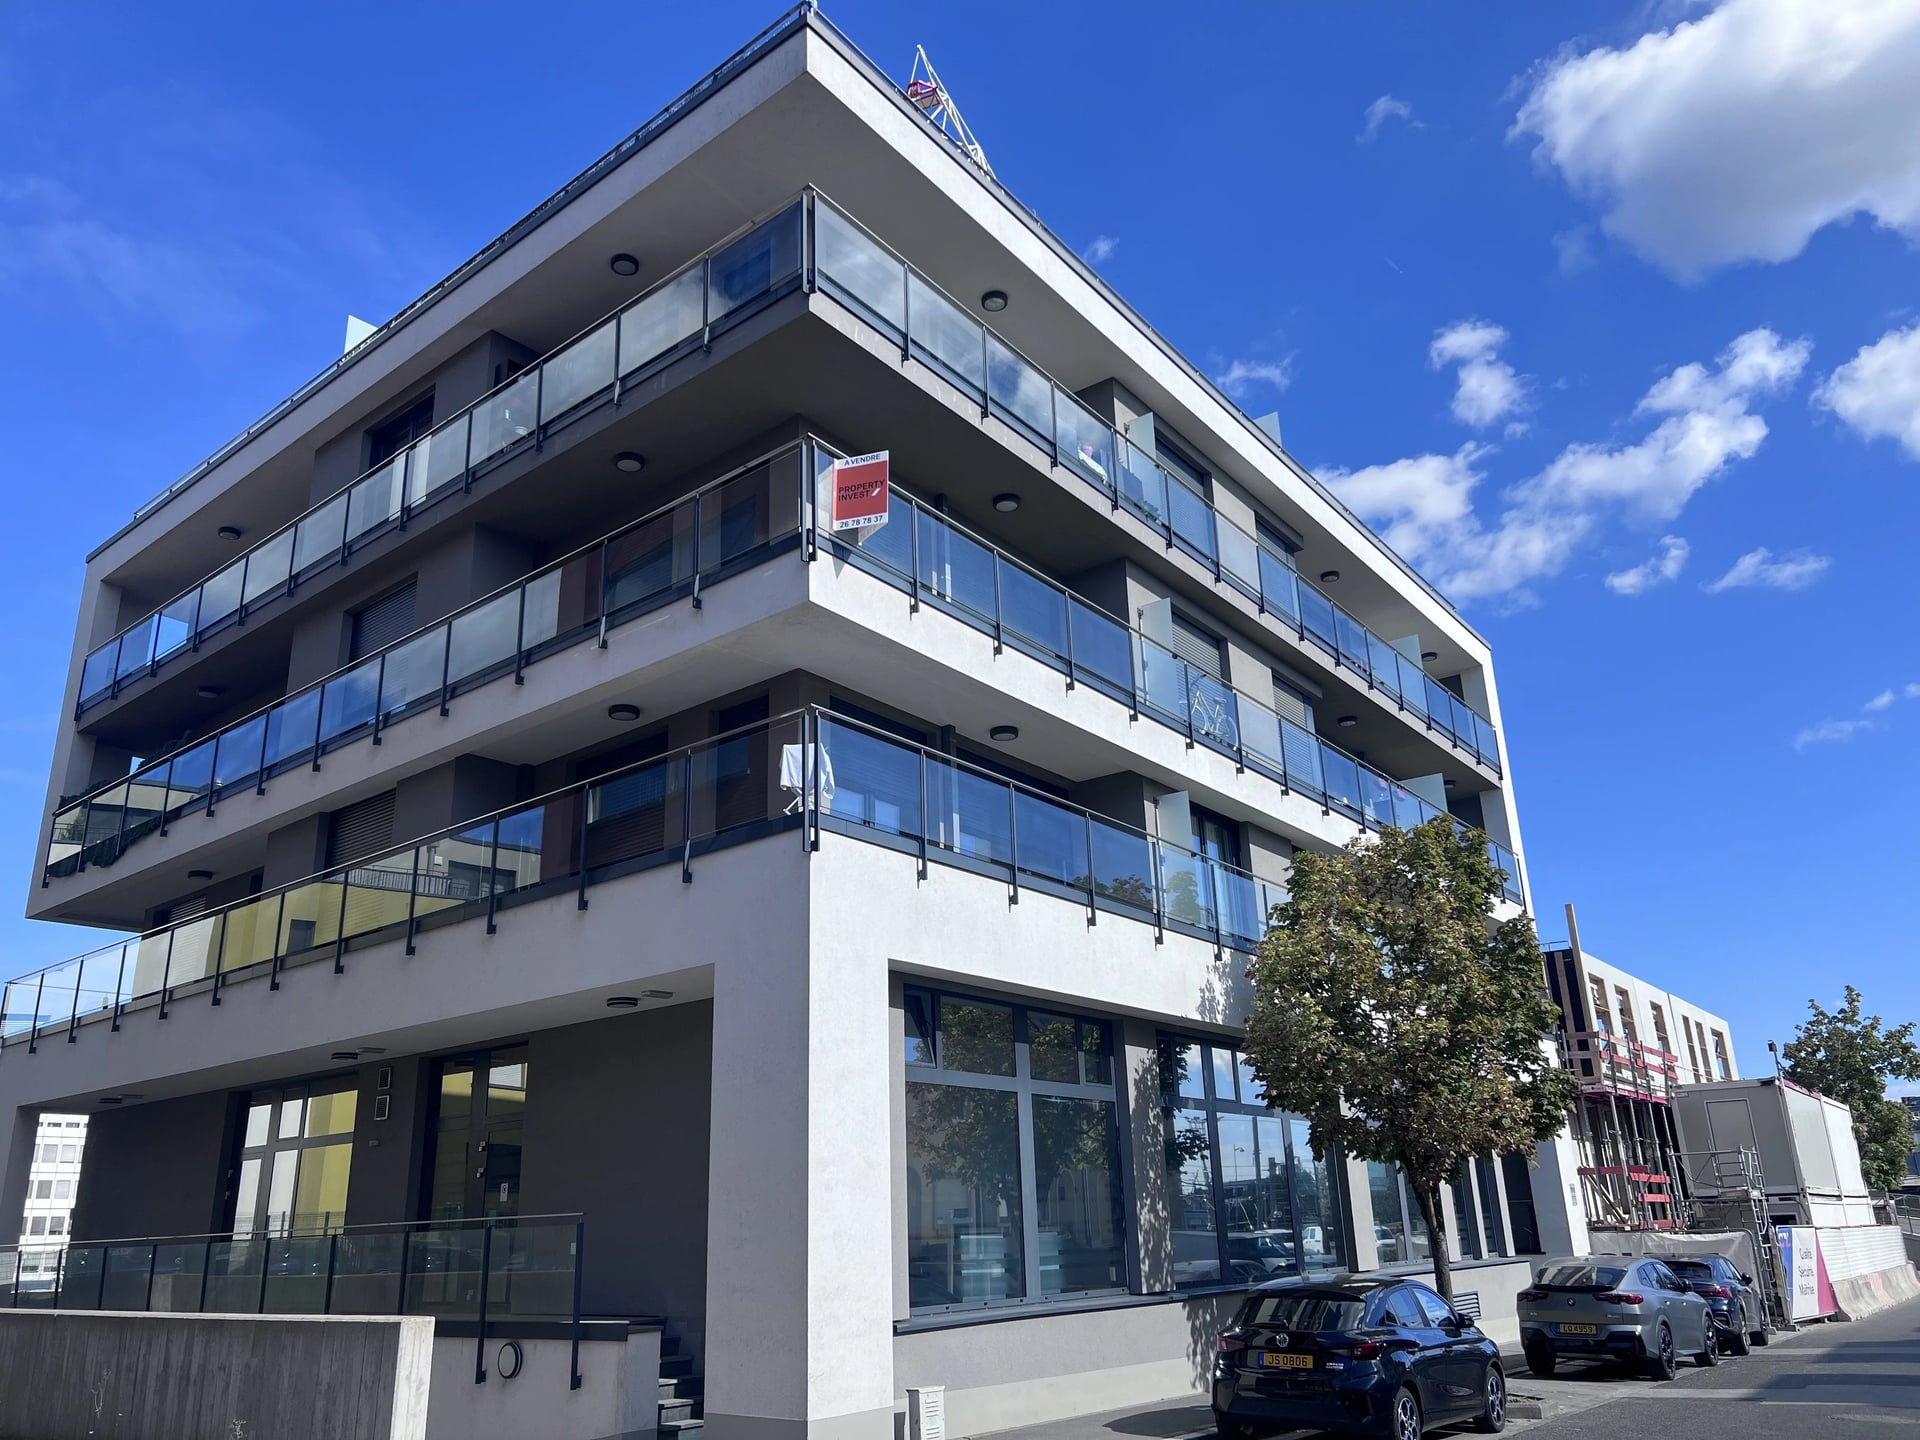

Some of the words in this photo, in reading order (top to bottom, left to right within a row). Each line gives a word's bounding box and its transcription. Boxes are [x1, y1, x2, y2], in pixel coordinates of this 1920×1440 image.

[851, 454, 881, 465] VENDRE
[839, 480, 885, 494] PROPERTY
[839, 490, 870, 502] INVEST
[840, 521, 849, 529] 26
[1269, 1355, 1281, 1365] JS
[1282, 1355, 1308, 1367] 0806
